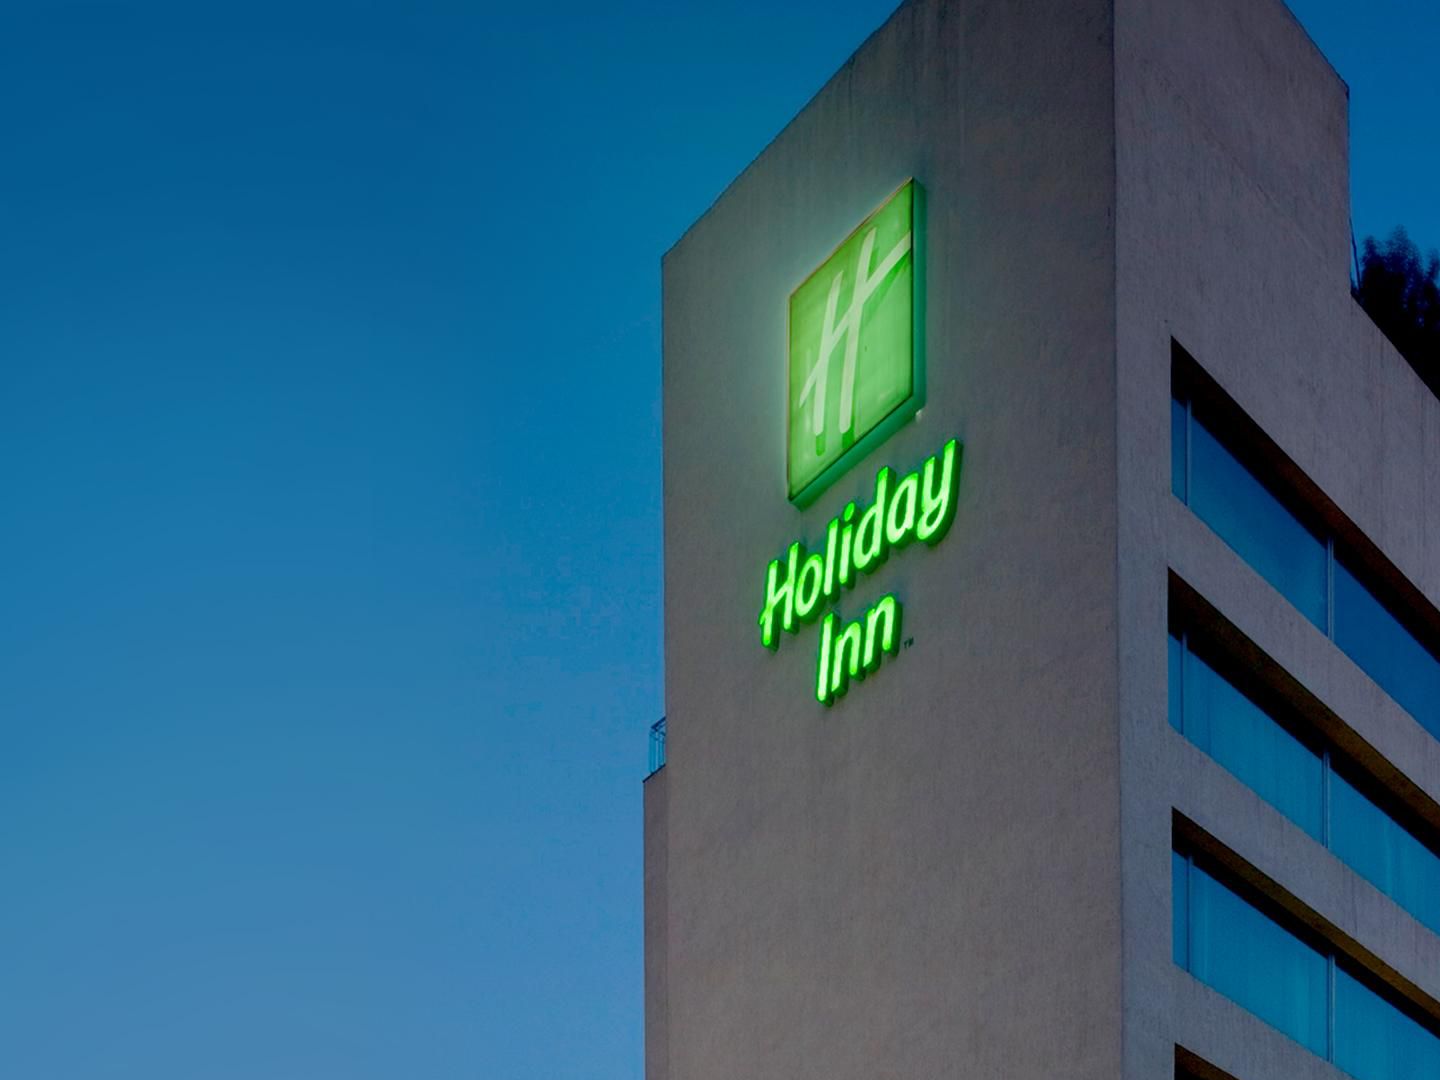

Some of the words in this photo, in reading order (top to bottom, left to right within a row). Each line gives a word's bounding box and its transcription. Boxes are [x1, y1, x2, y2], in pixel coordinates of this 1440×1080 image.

[798, 227, 912, 435] H
[759, 438, 961, 651] Holiday
[815, 594, 901, 706] Inn
